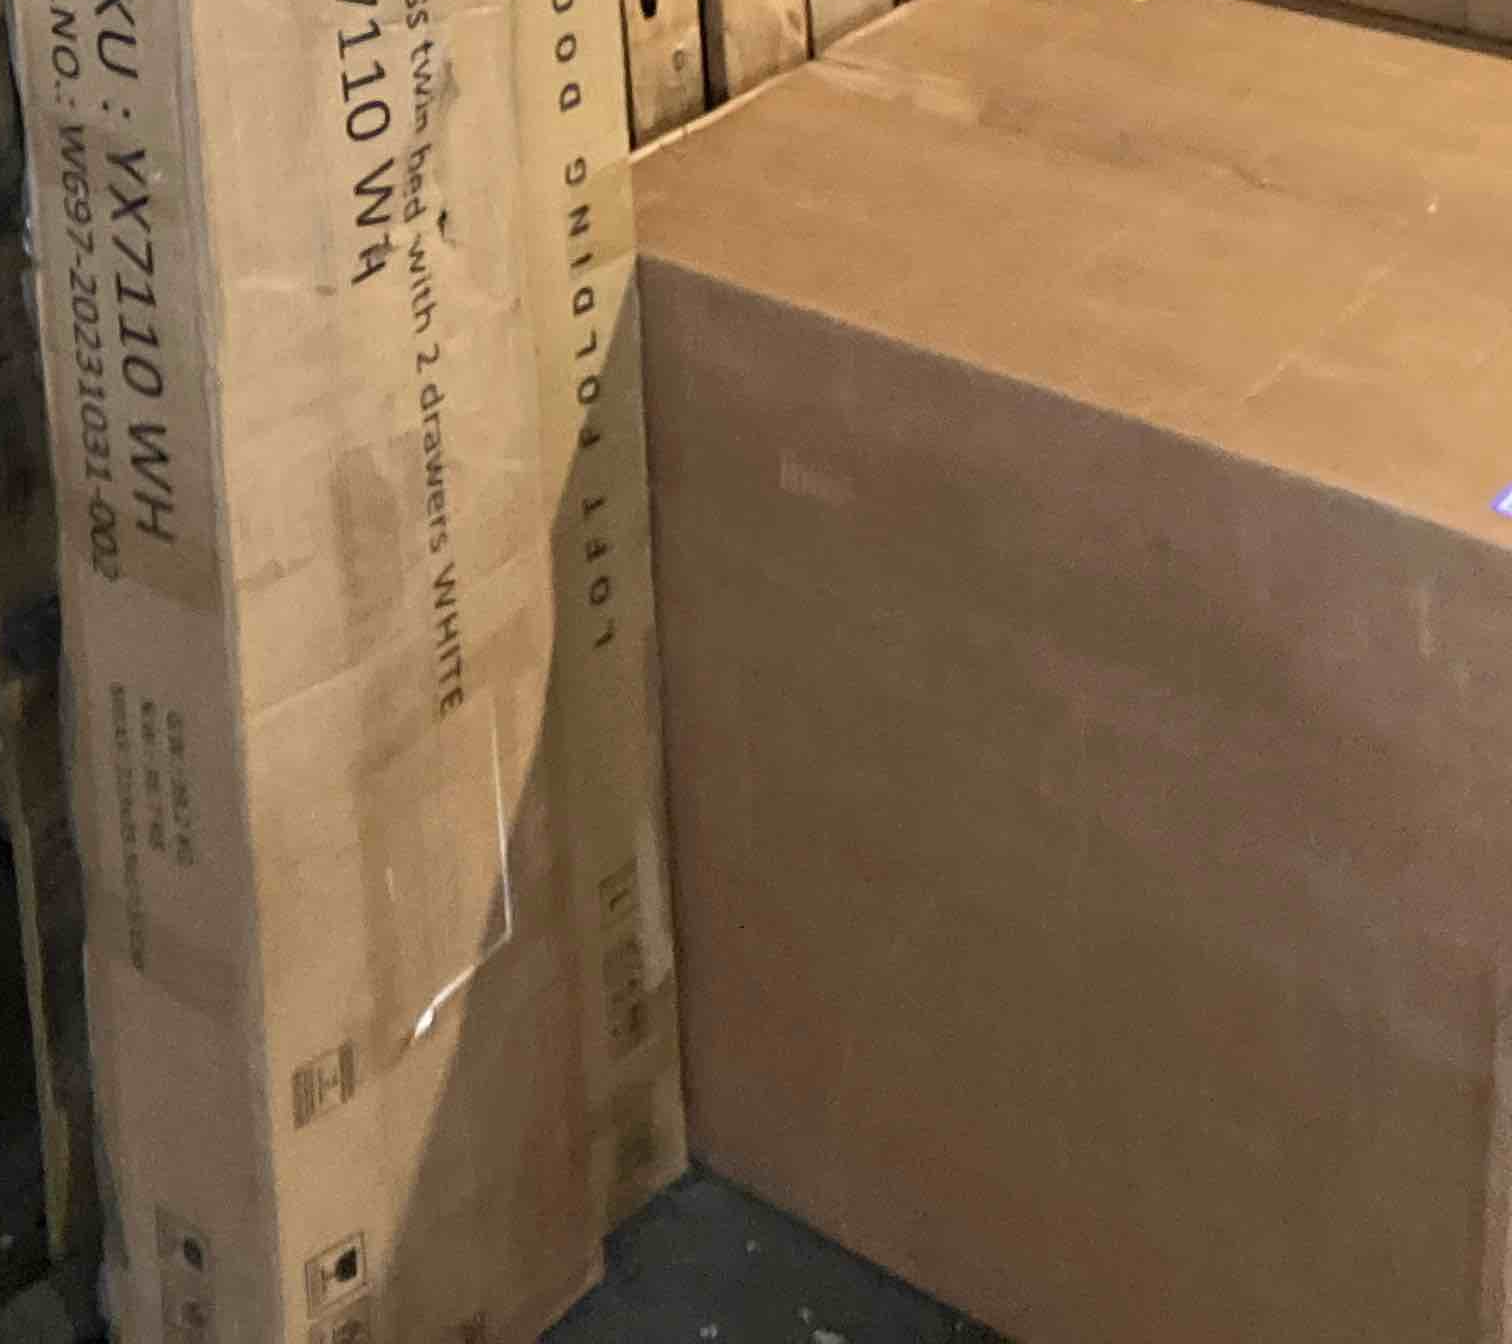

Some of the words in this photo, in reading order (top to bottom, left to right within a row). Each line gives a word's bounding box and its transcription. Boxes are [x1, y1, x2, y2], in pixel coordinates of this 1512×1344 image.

[409, 39, 436, 134] twin
[105, 149, 164, 398] YX7110
[407, 232, 441, 334] with
[564, 157, 601, 450] FOLDING
[416, 343, 441, 375] 2
[127, 423, 175, 543] WH
[419, 383, 449, 555] drawers
[433, 561, 465, 717] WHITE
